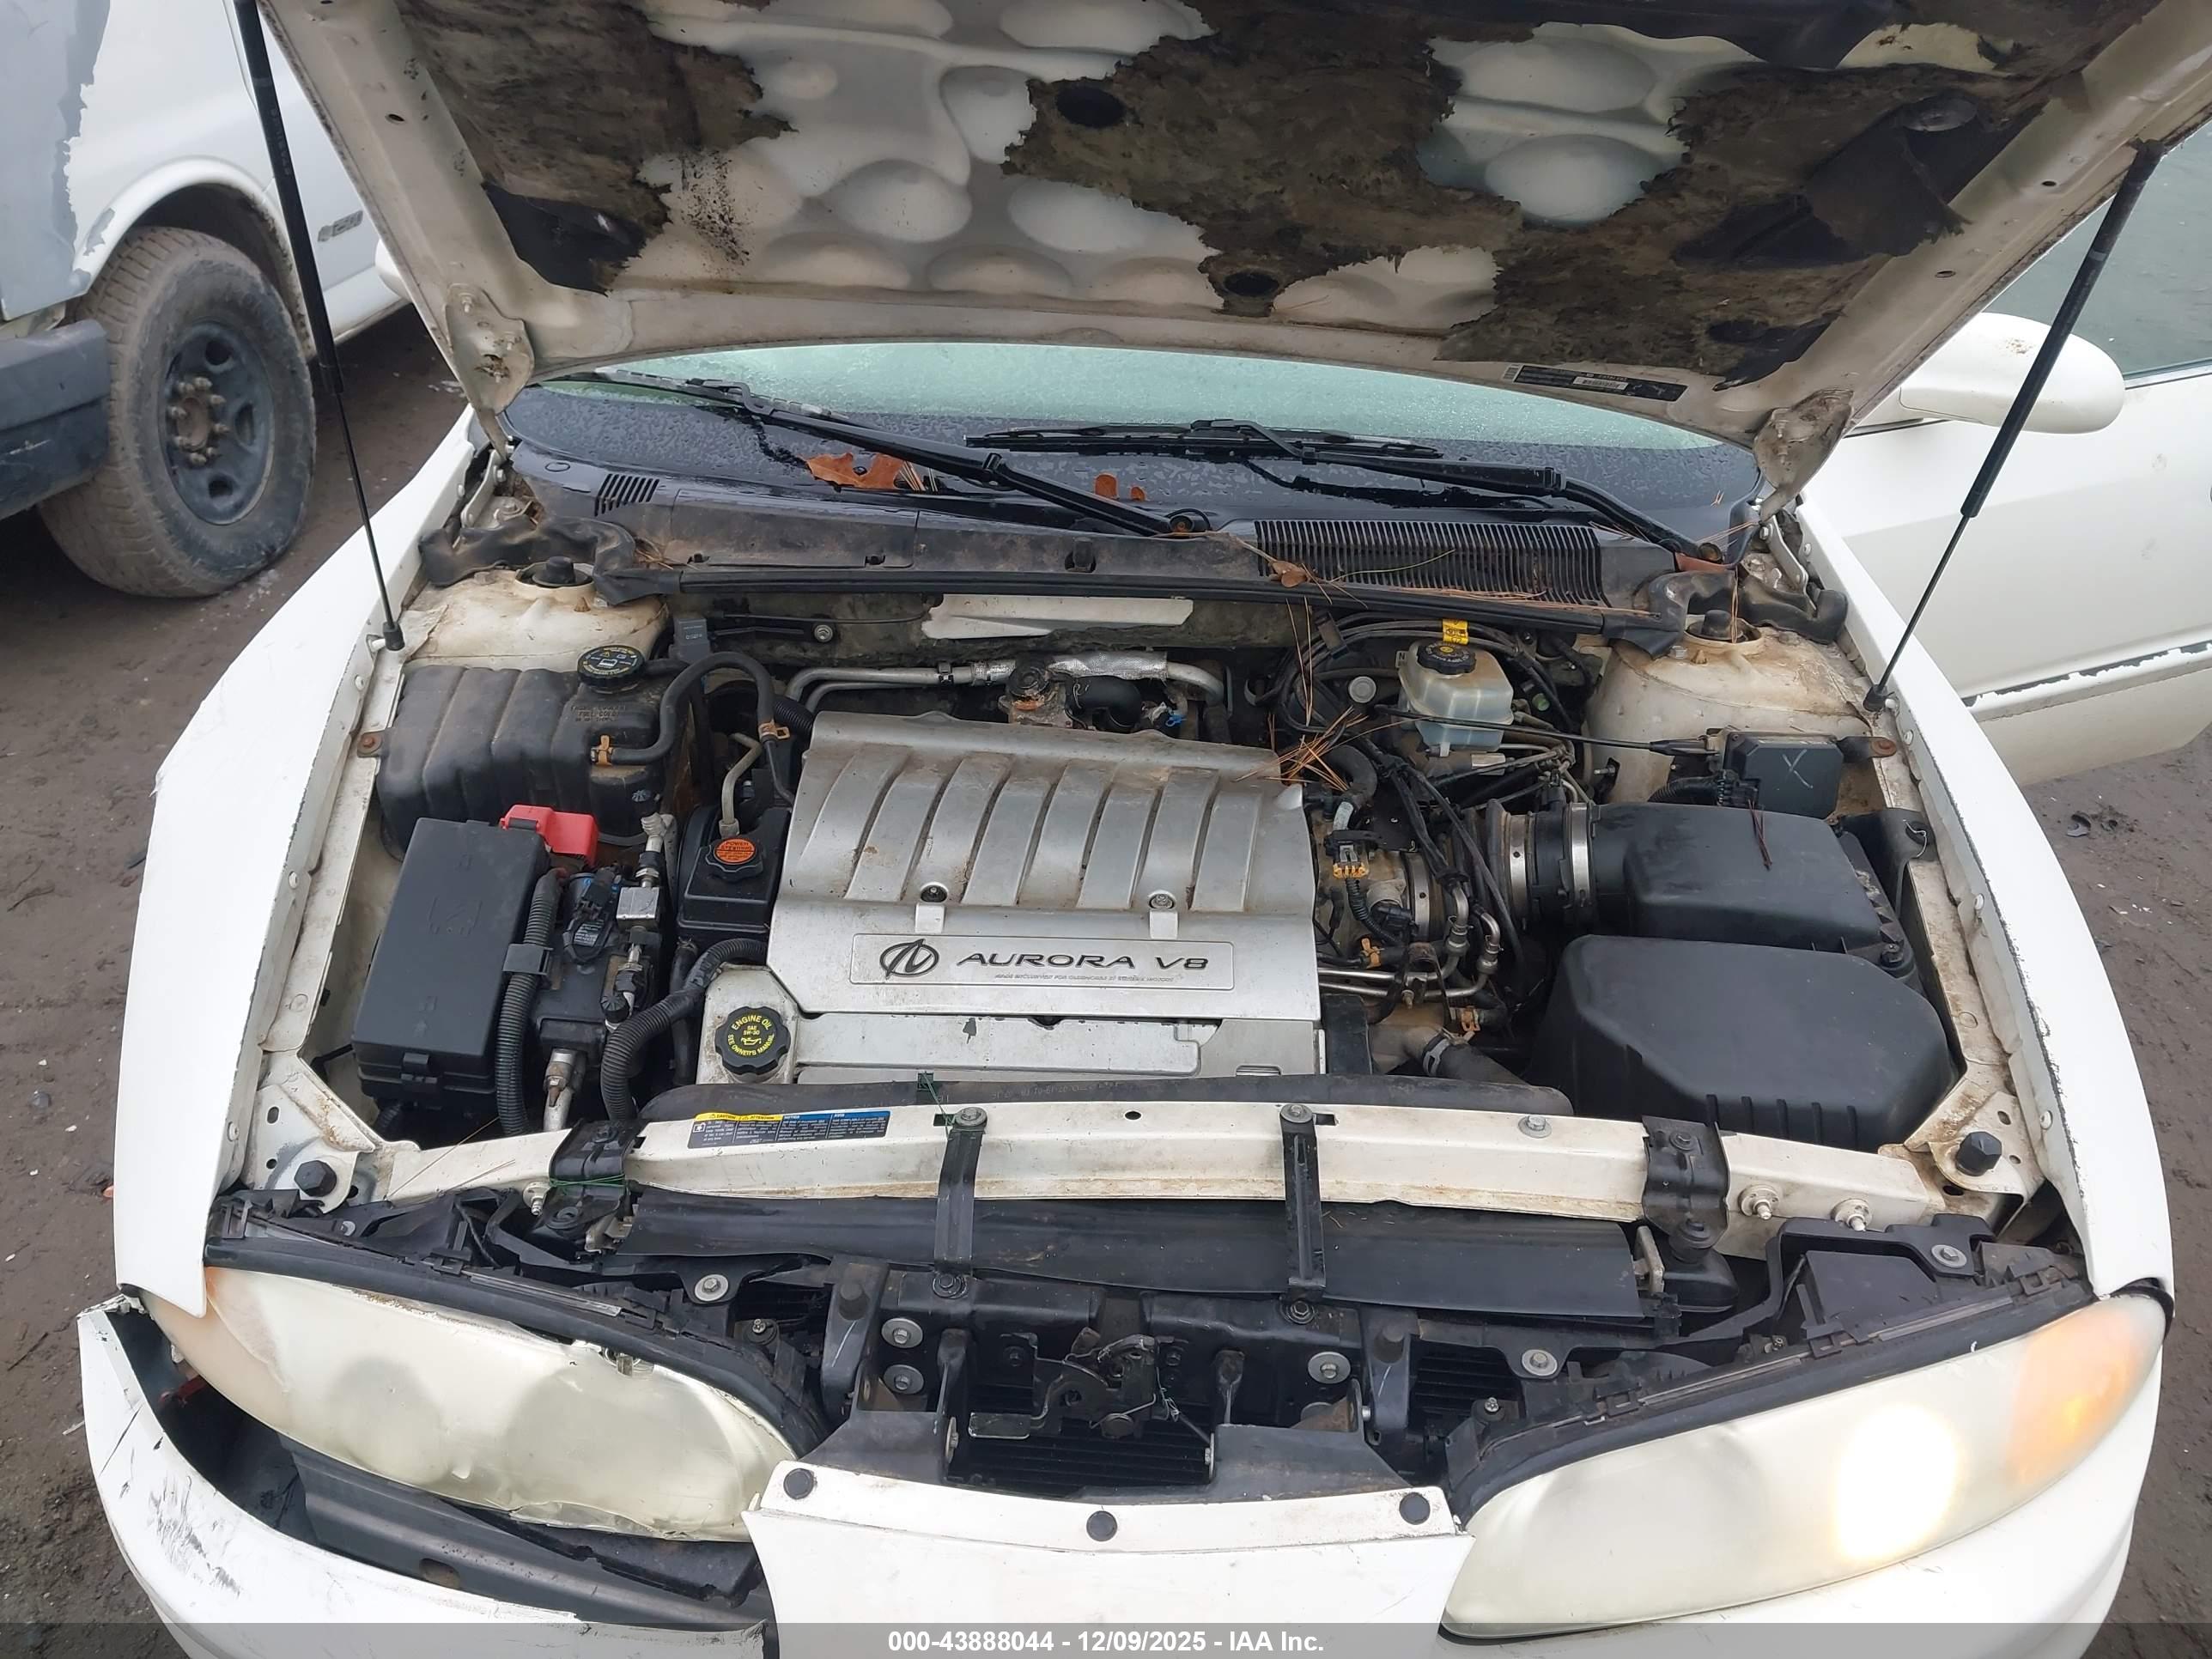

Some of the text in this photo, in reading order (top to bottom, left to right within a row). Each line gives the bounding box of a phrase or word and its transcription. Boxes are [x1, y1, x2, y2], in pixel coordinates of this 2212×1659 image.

[956, 952, 1209, 970] AURORA V8
[731, 1014, 772, 1030] ENGINE OIL
